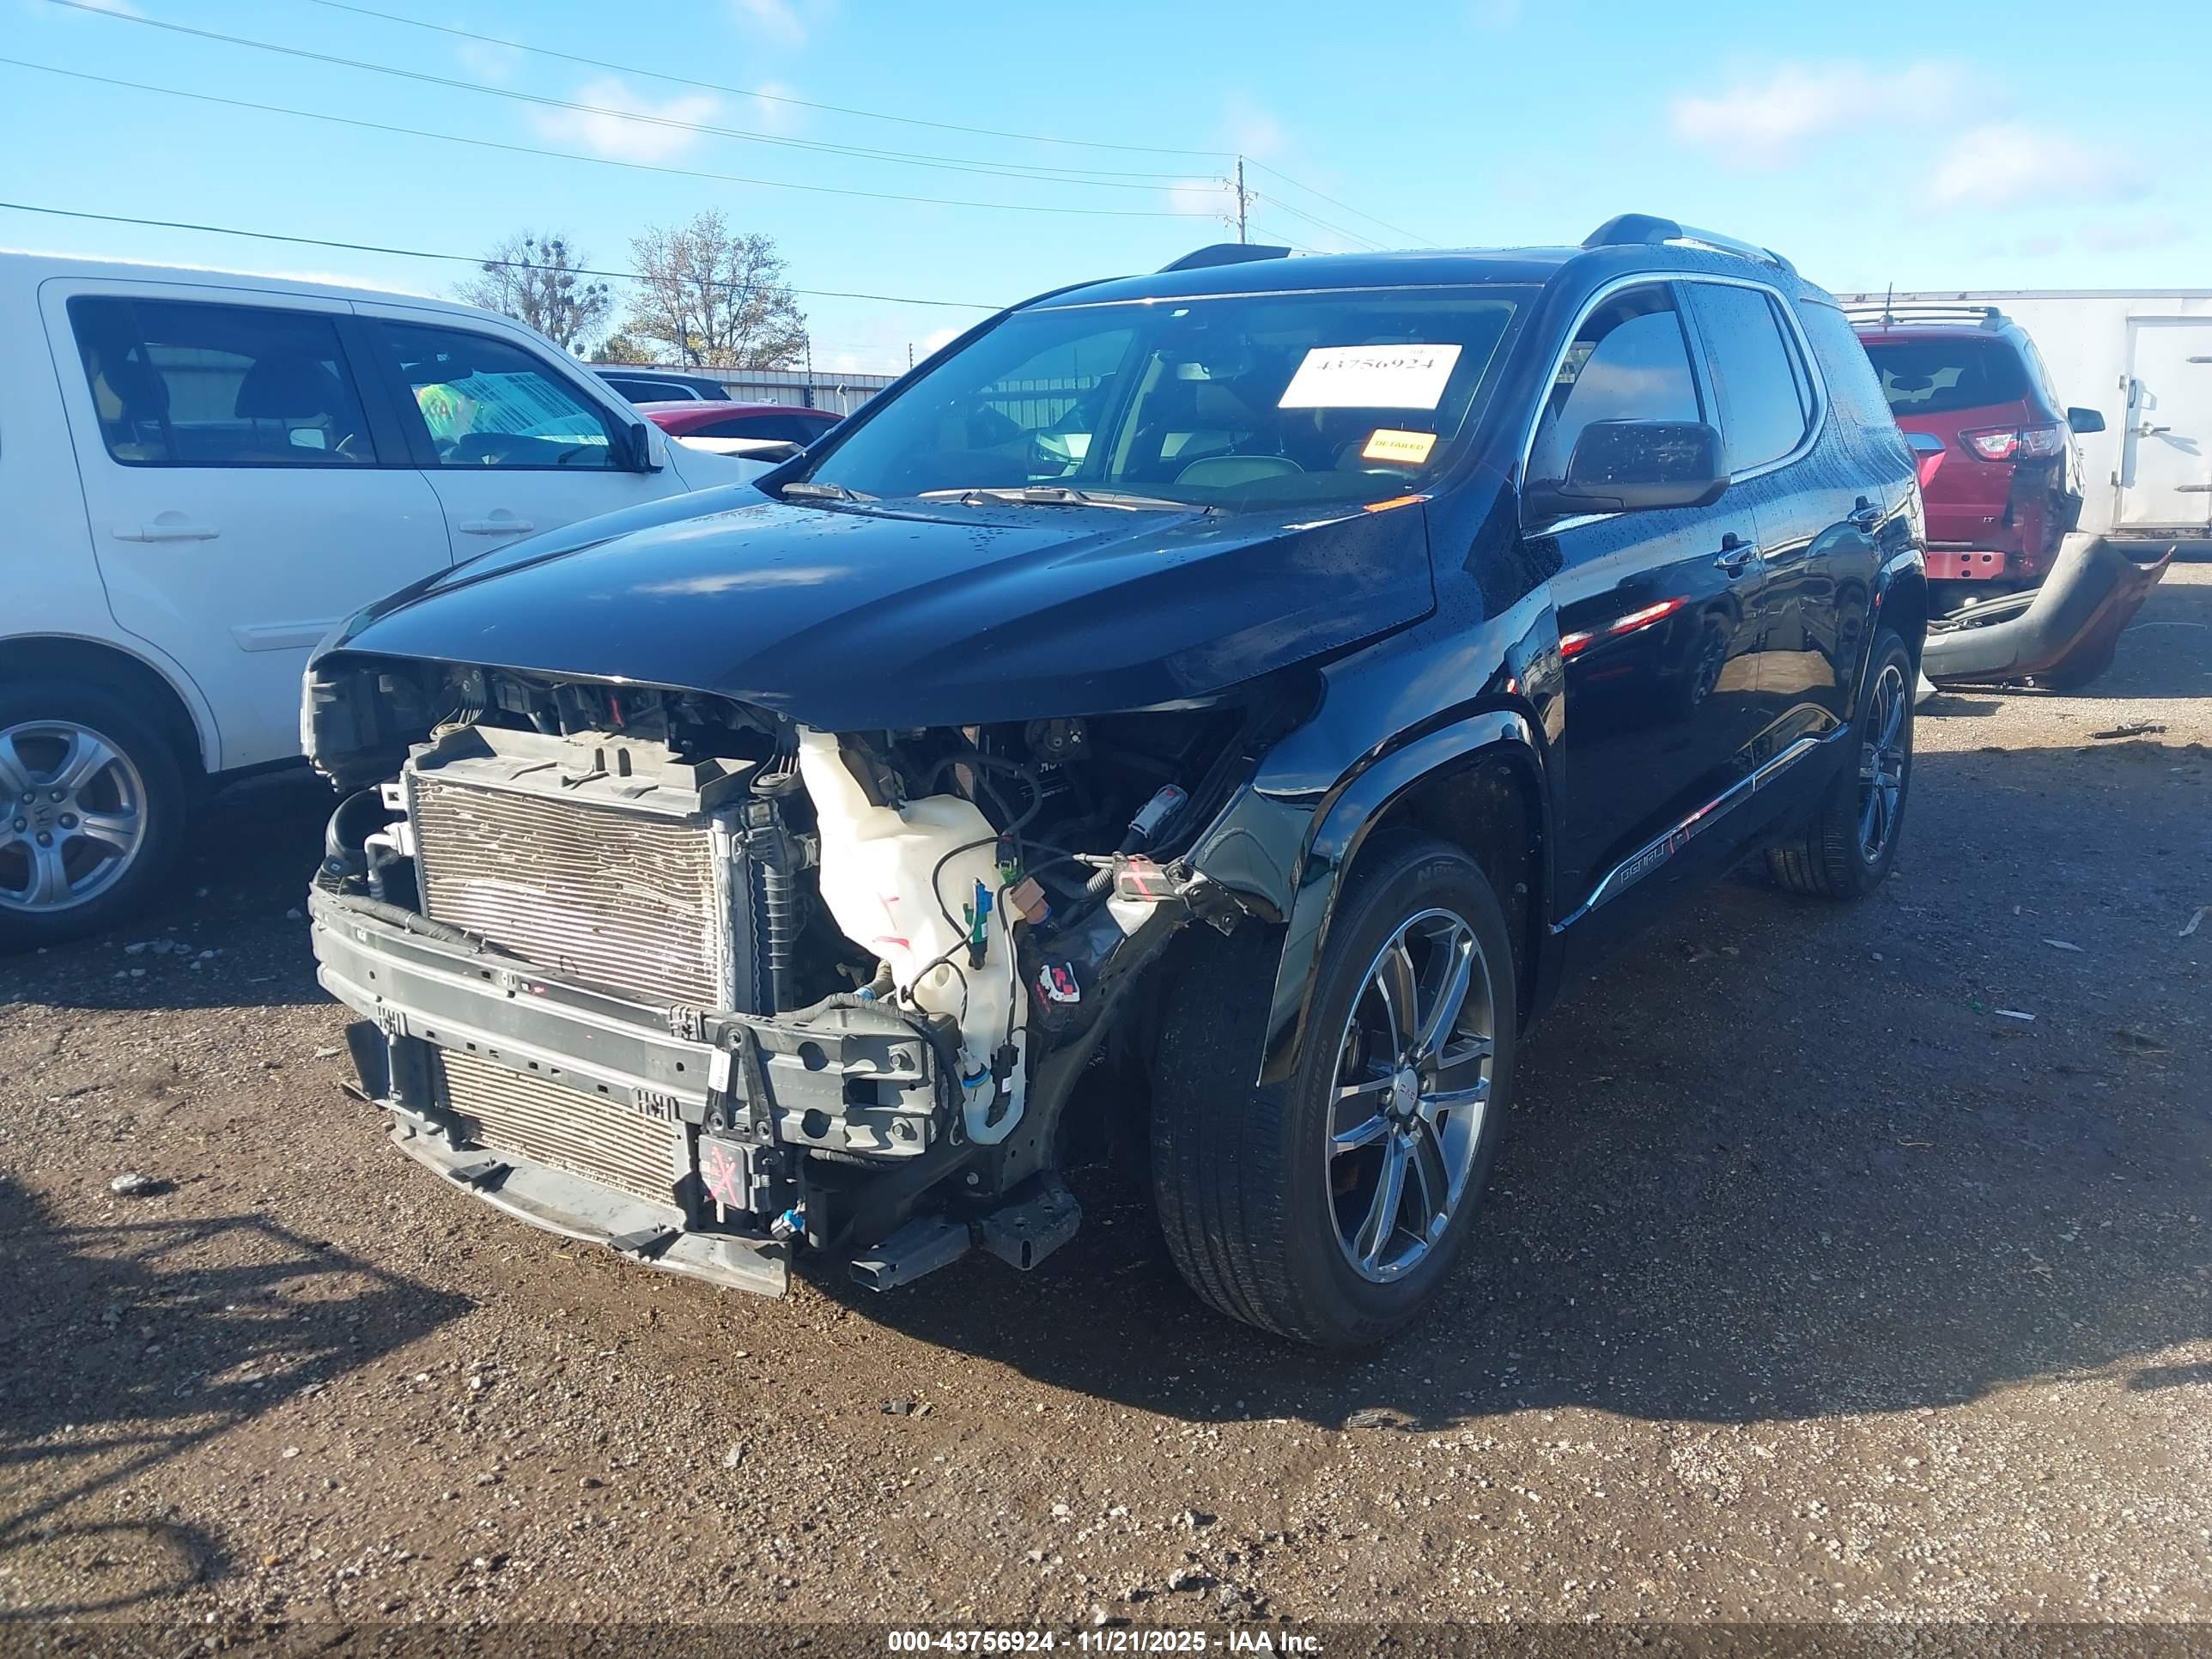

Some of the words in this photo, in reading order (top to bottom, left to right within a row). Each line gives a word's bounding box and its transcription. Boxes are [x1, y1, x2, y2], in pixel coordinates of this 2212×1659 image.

[1317, 357, 1435, 370] 43756924
[1374, 440, 1425, 451] DETAILED
[1620, 843, 1665, 884] DENALI
